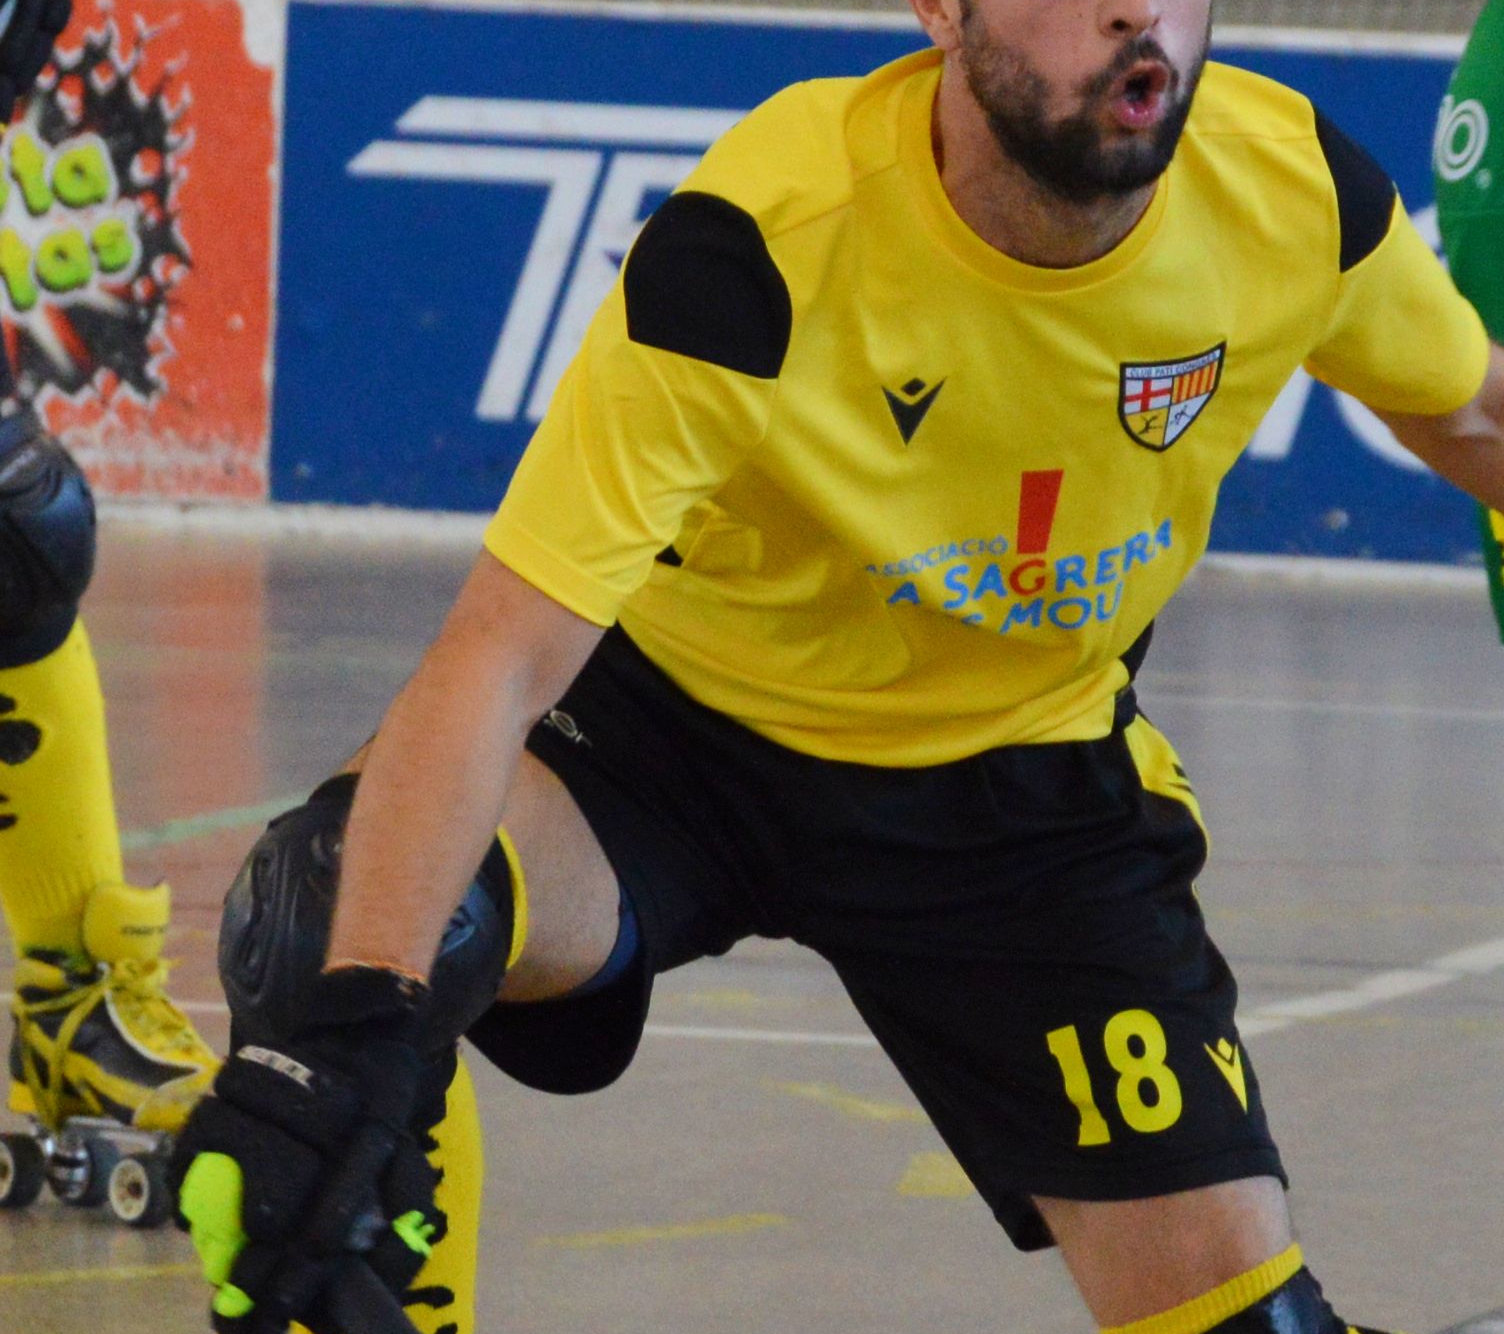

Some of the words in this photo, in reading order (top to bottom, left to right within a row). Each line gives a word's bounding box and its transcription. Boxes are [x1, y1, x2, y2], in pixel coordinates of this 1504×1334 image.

[942, 517, 1172, 611] SAGRERA
[999, 580, 1125, 635] MOU
[1045, 1008, 1183, 1148] 18
